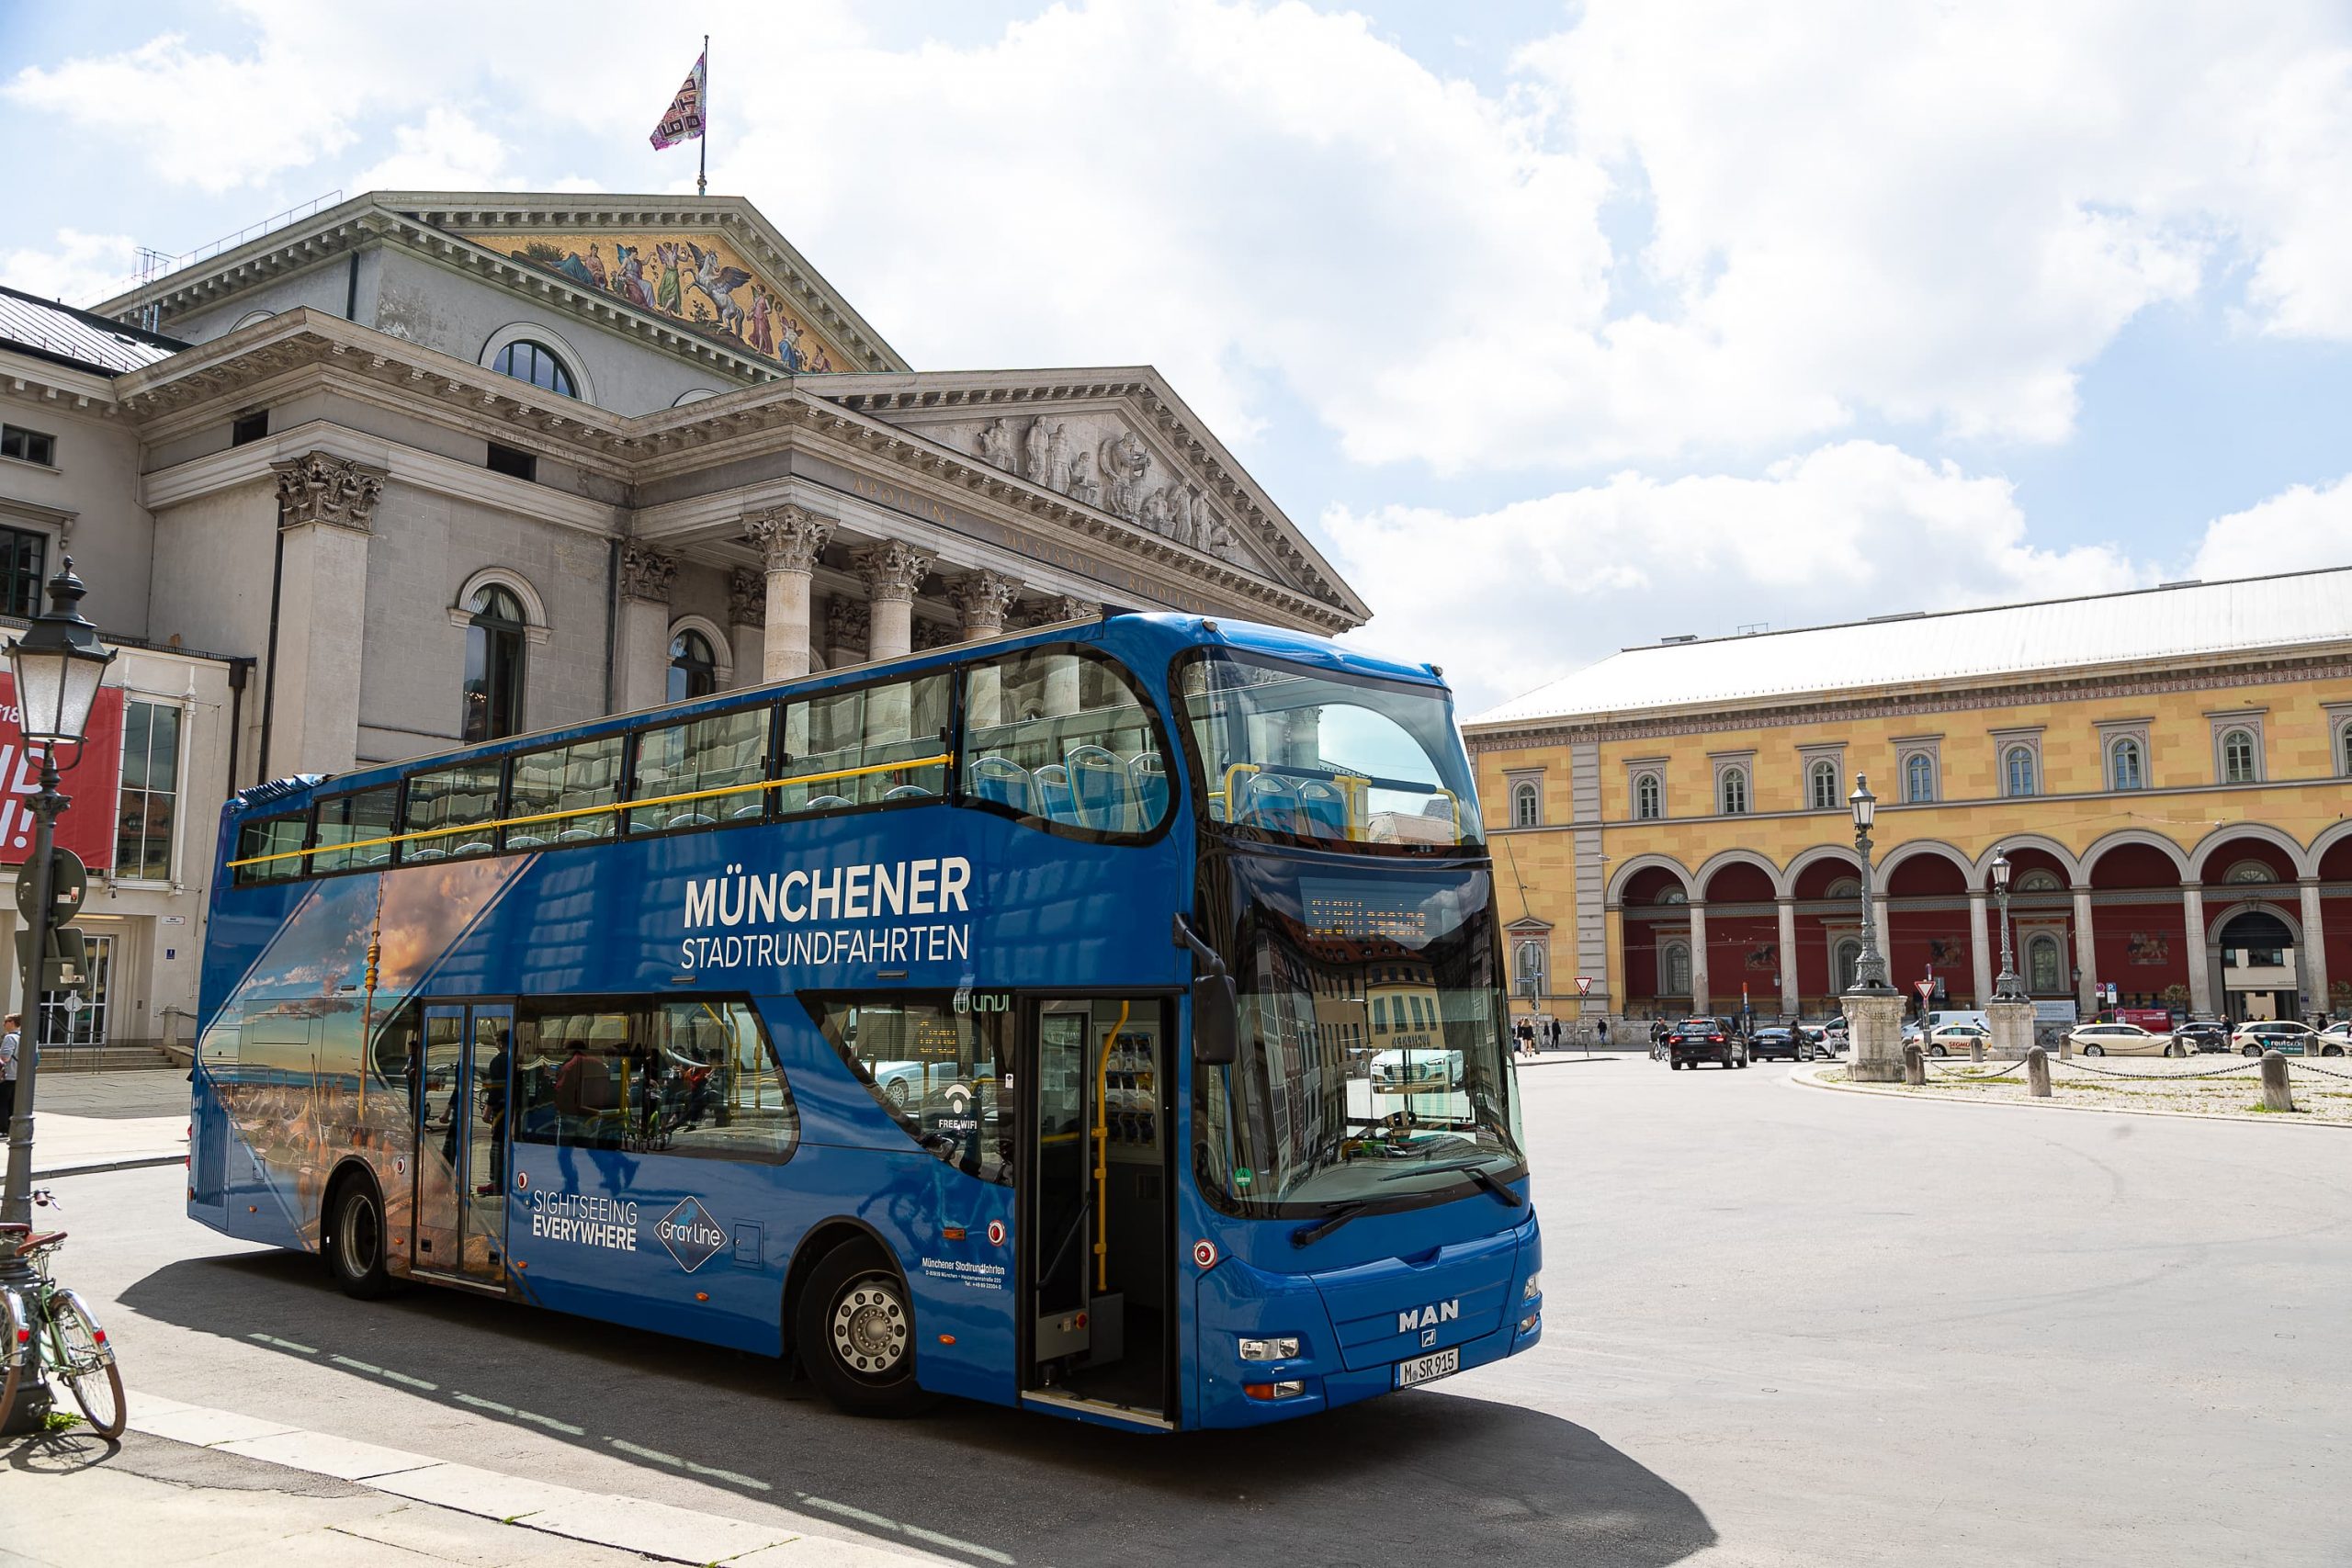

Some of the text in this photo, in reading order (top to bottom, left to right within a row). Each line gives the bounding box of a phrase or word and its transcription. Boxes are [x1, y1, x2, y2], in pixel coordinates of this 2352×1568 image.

[853, 478, 956, 526] APOLLINI
[683, 856, 971, 929] MÜNCHENER
[681, 923, 969, 970] STADTRUNDFAHRTEN
[938, 1119, 978, 1130] FREE WIFI
[533, 1190, 638, 1225] SIGHTSEEING
[532, 1214, 637, 1251] EVERYWHERE
[922, 1257, 1005, 1275] Münchener Stadtrundfahrten
[1398, 1299, 1459, 1334] MAN
[1404, 1364, 1412, 1382] M
[1419, 1359, 1433, 1378] SR
[1435, 1352, 1454, 1373] 915
